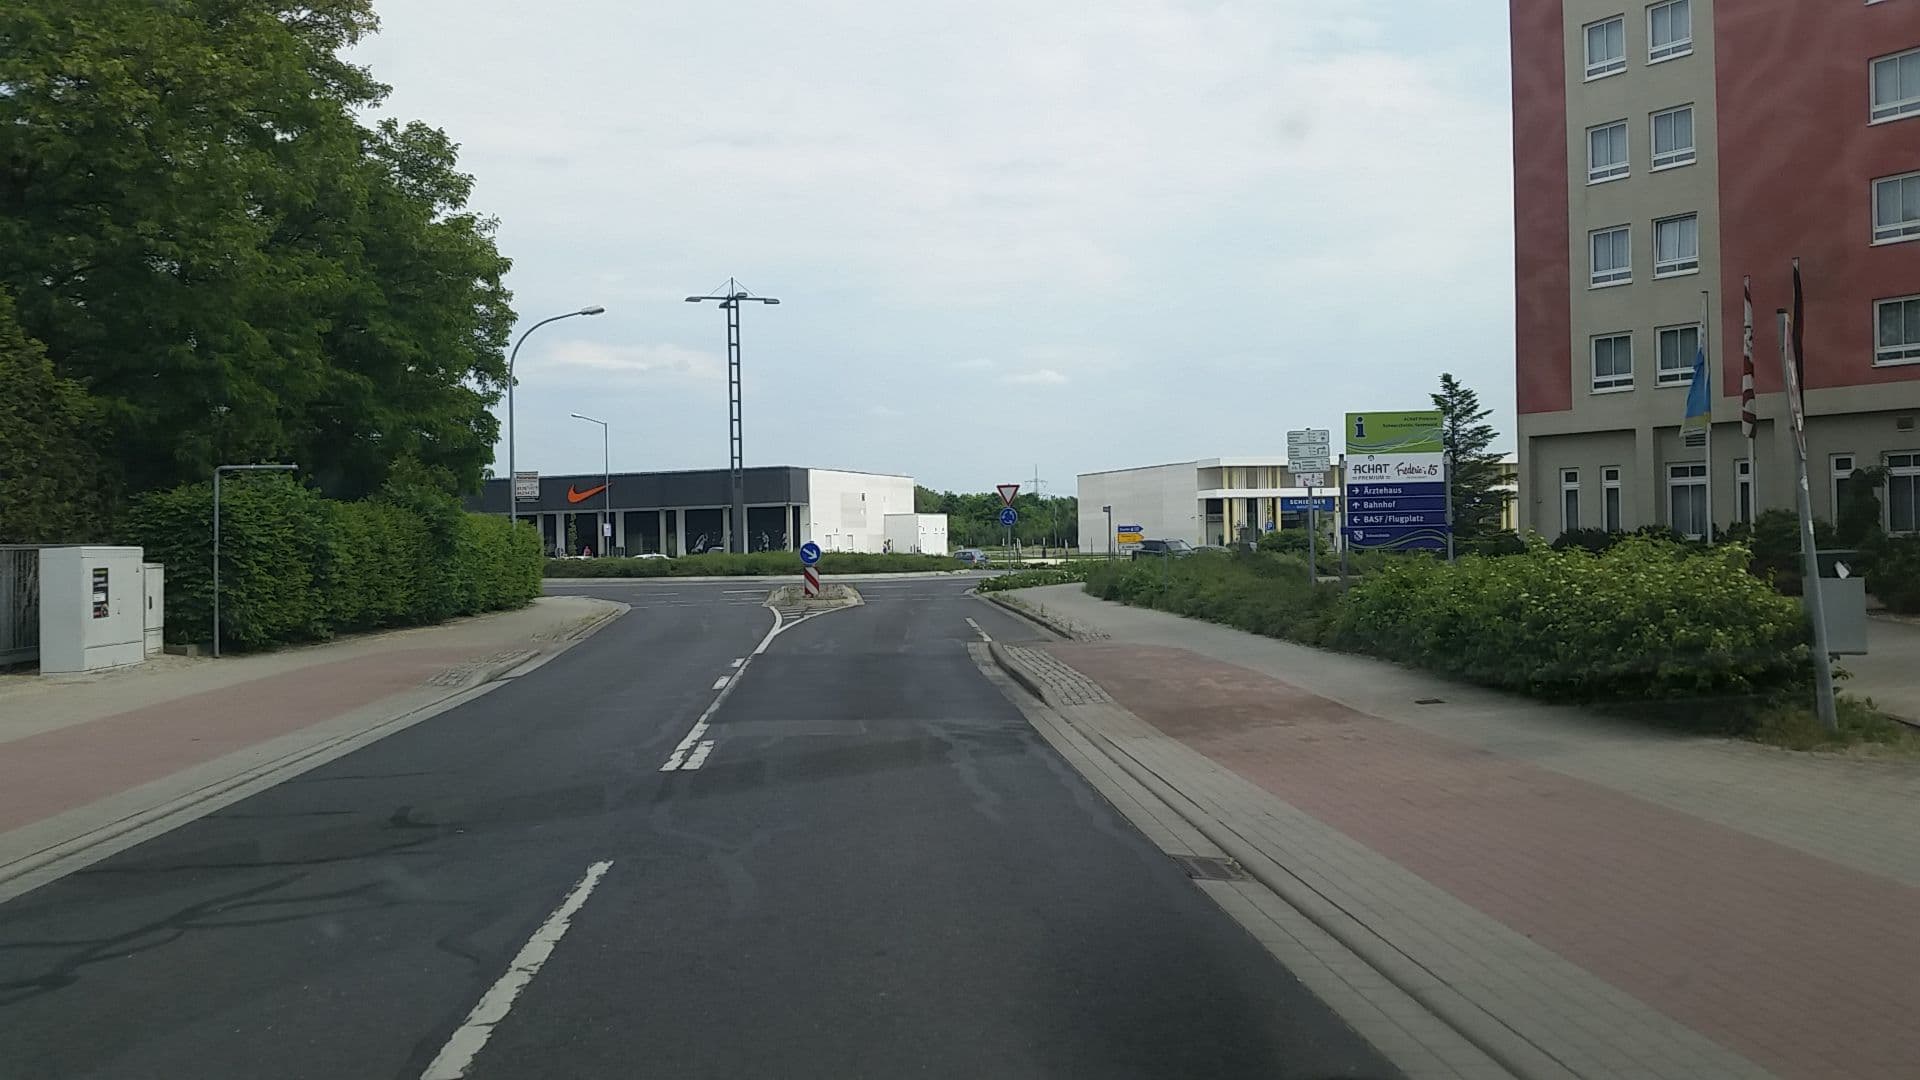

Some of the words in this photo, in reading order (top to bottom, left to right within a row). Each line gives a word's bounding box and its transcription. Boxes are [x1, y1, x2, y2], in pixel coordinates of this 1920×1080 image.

[1352, 464, 1390, 474] ACHAT
[1363, 486, 1402, 495] Ärztehaus
[1363, 500, 1396, 509] Bahnhof
[1363, 514, 1384, 523] BASF
